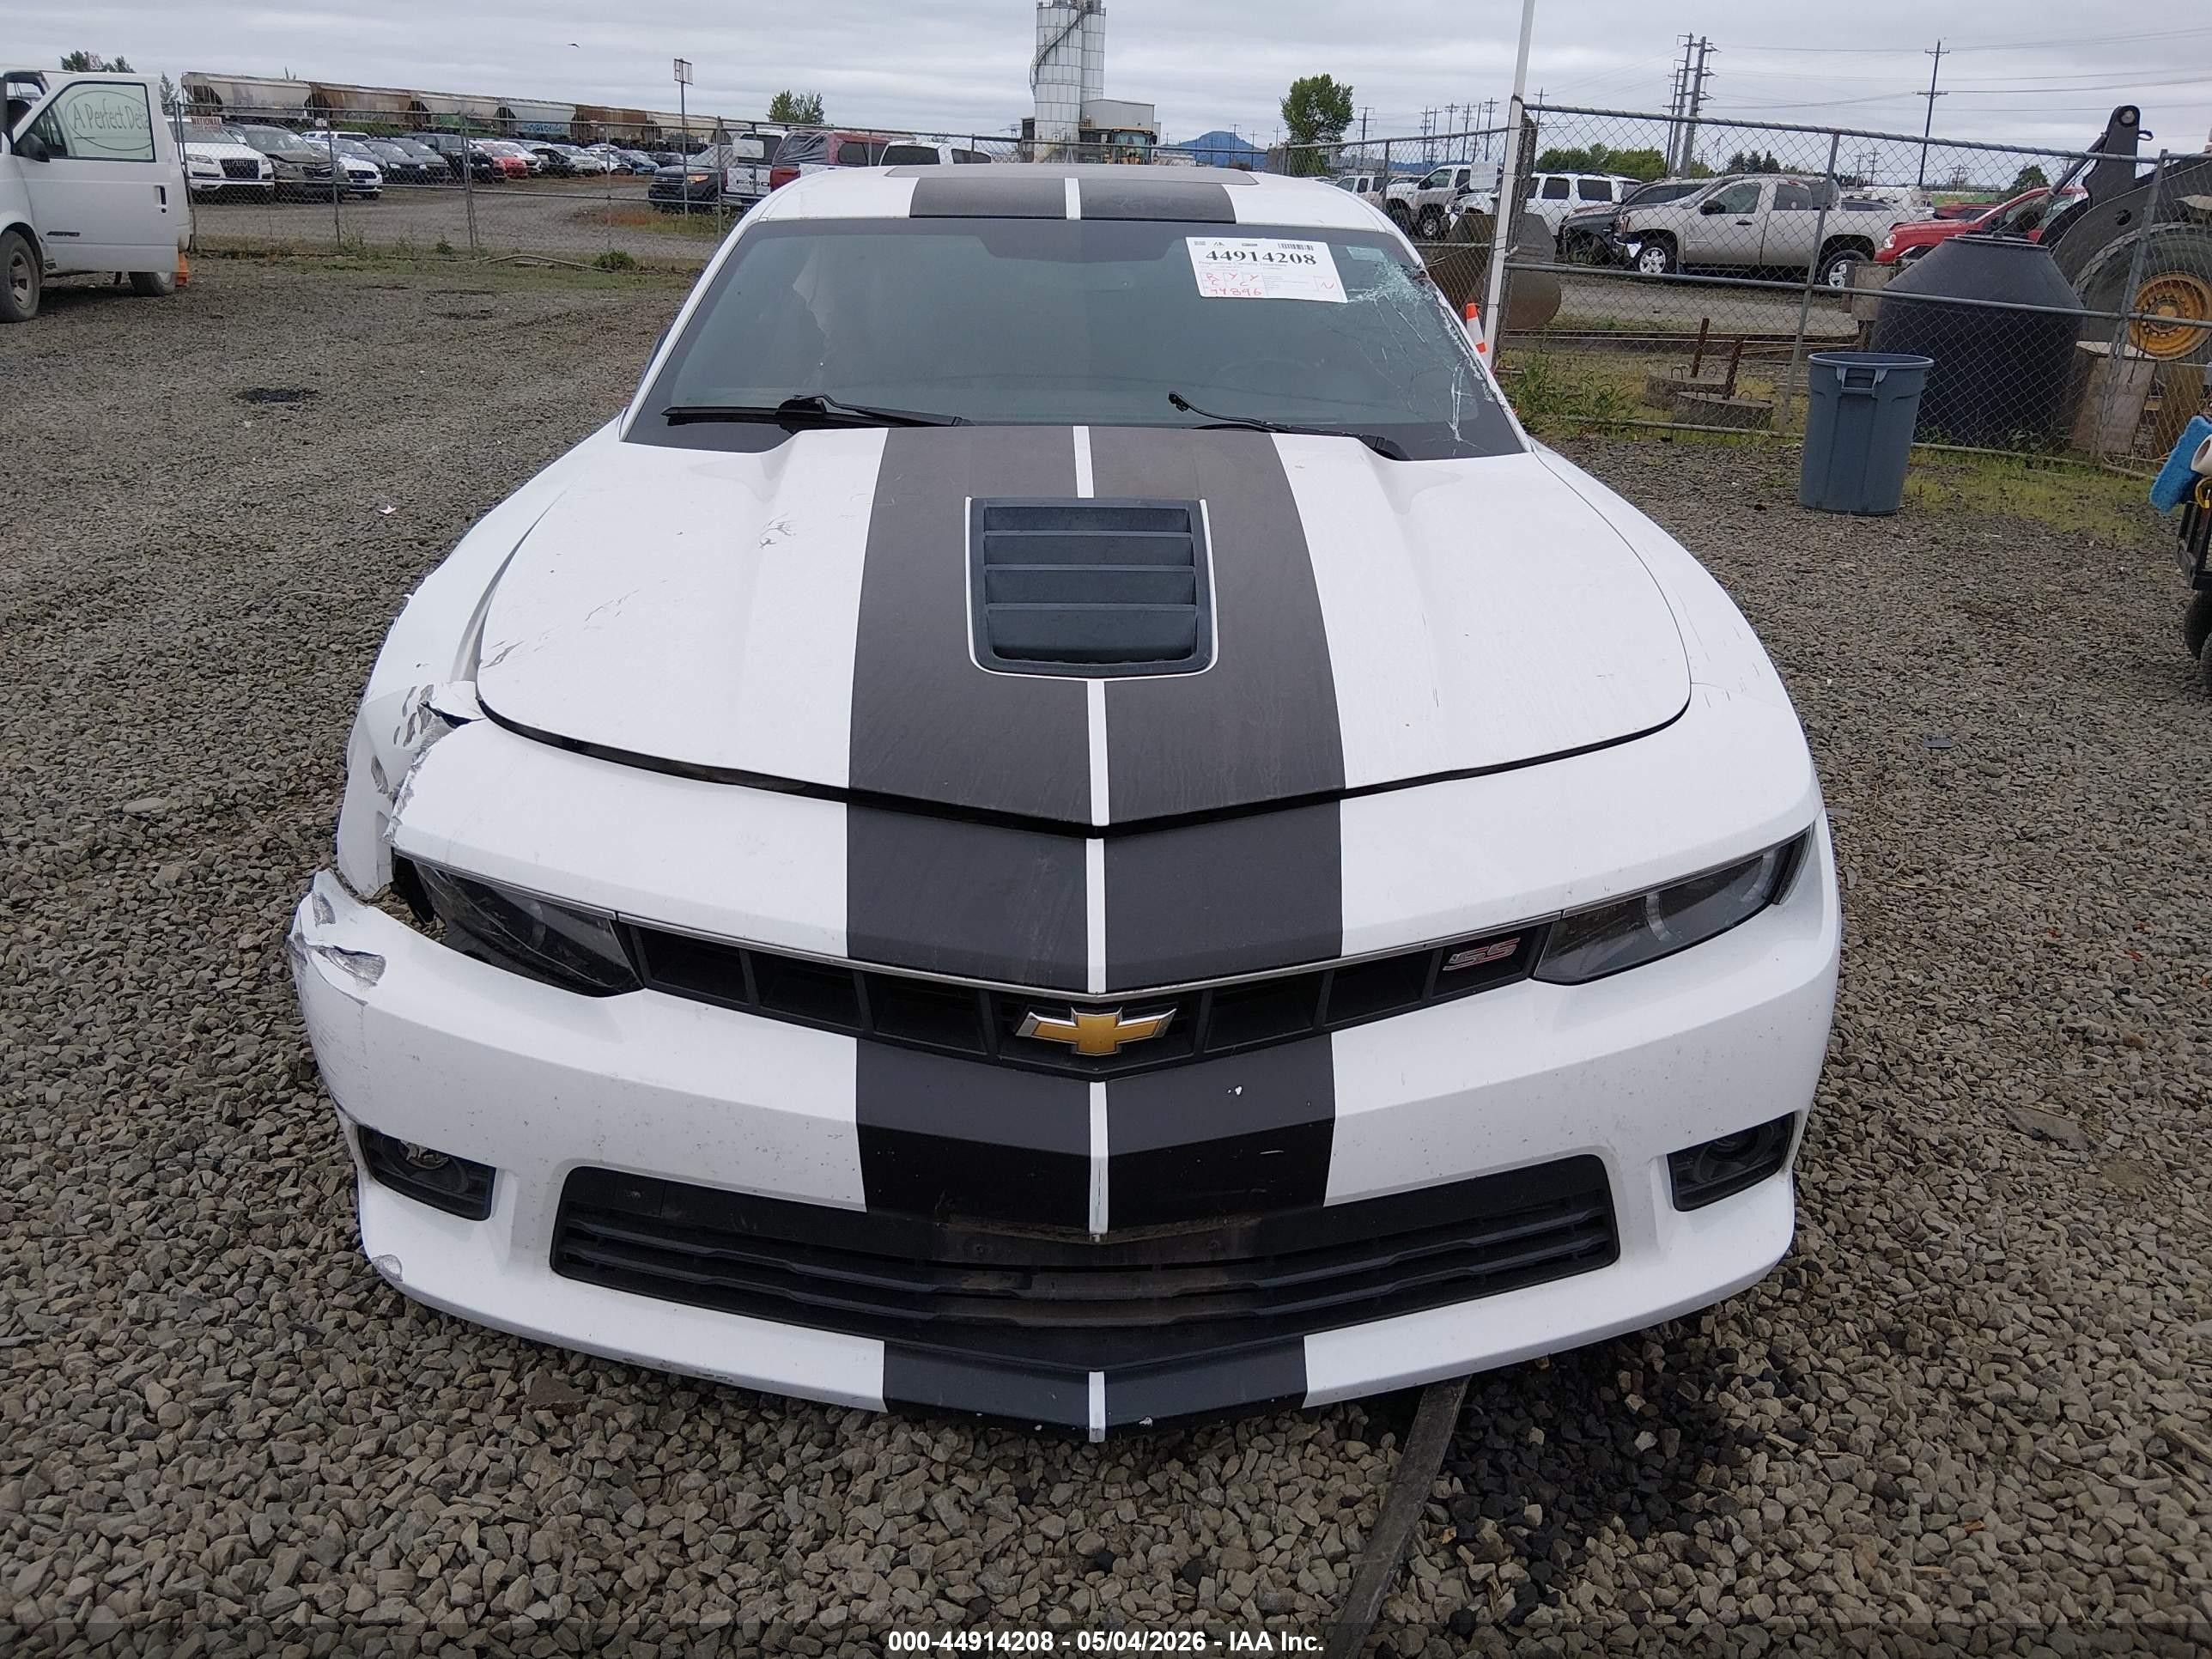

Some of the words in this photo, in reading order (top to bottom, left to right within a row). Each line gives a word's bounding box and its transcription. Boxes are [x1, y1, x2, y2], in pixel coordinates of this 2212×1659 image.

[73, 102, 86, 130] A
[84, 98, 127, 130] Perfect
[1206, 250, 1317, 265] 44914208
[1443, 937, 1521, 971] SS
